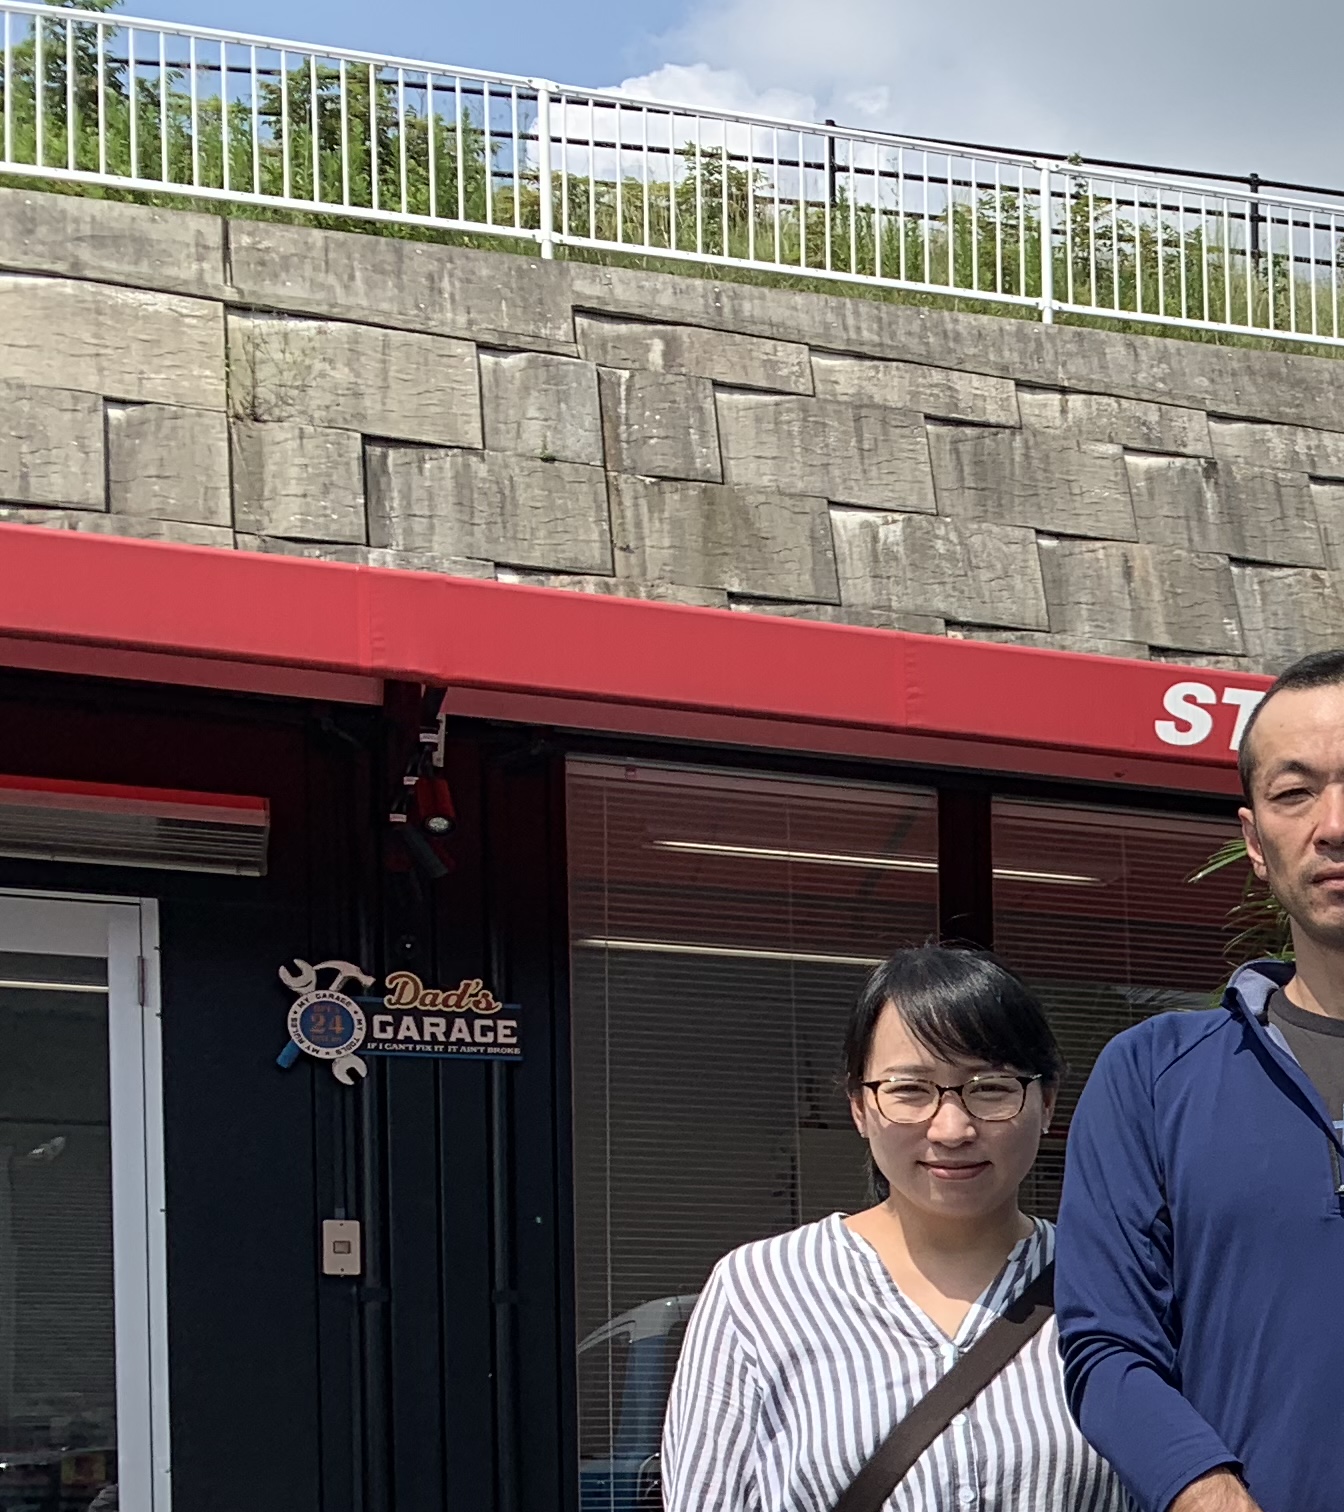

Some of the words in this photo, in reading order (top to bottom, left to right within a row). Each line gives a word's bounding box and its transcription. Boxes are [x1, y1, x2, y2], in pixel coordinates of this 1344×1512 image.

[315, 993, 352, 1007] GARAGE
[384, 971, 502, 1014] Dad's
[310, 1014, 344, 1034] 24
[372, 1014, 518, 1044] GARAGE
[487, 1047, 521, 1055] BROKE
